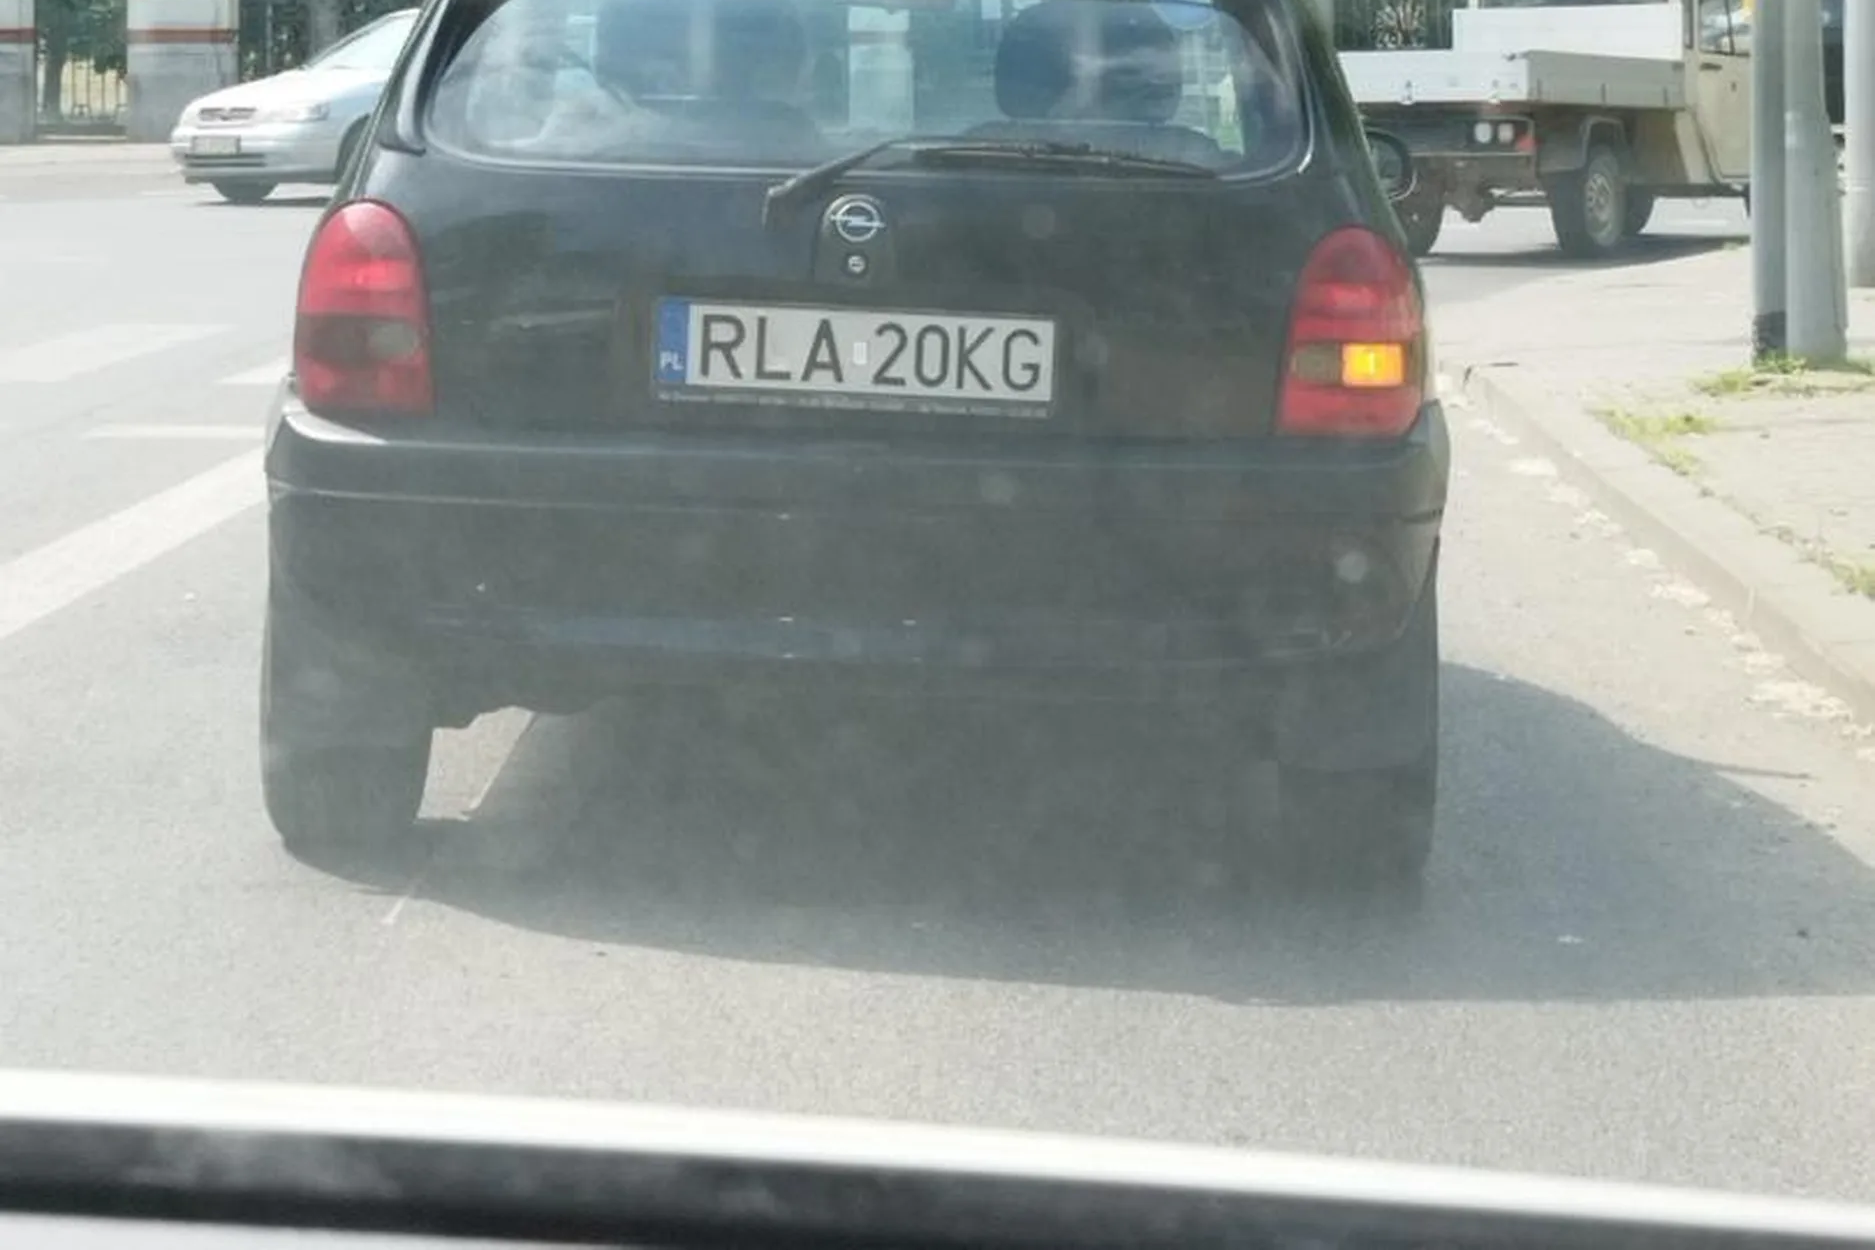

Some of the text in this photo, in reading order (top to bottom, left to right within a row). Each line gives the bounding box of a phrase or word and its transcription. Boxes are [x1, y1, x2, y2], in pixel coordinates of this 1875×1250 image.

[660, 351, 684, 371] PL
[701, 313, 1041, 392] RLA 20KG
